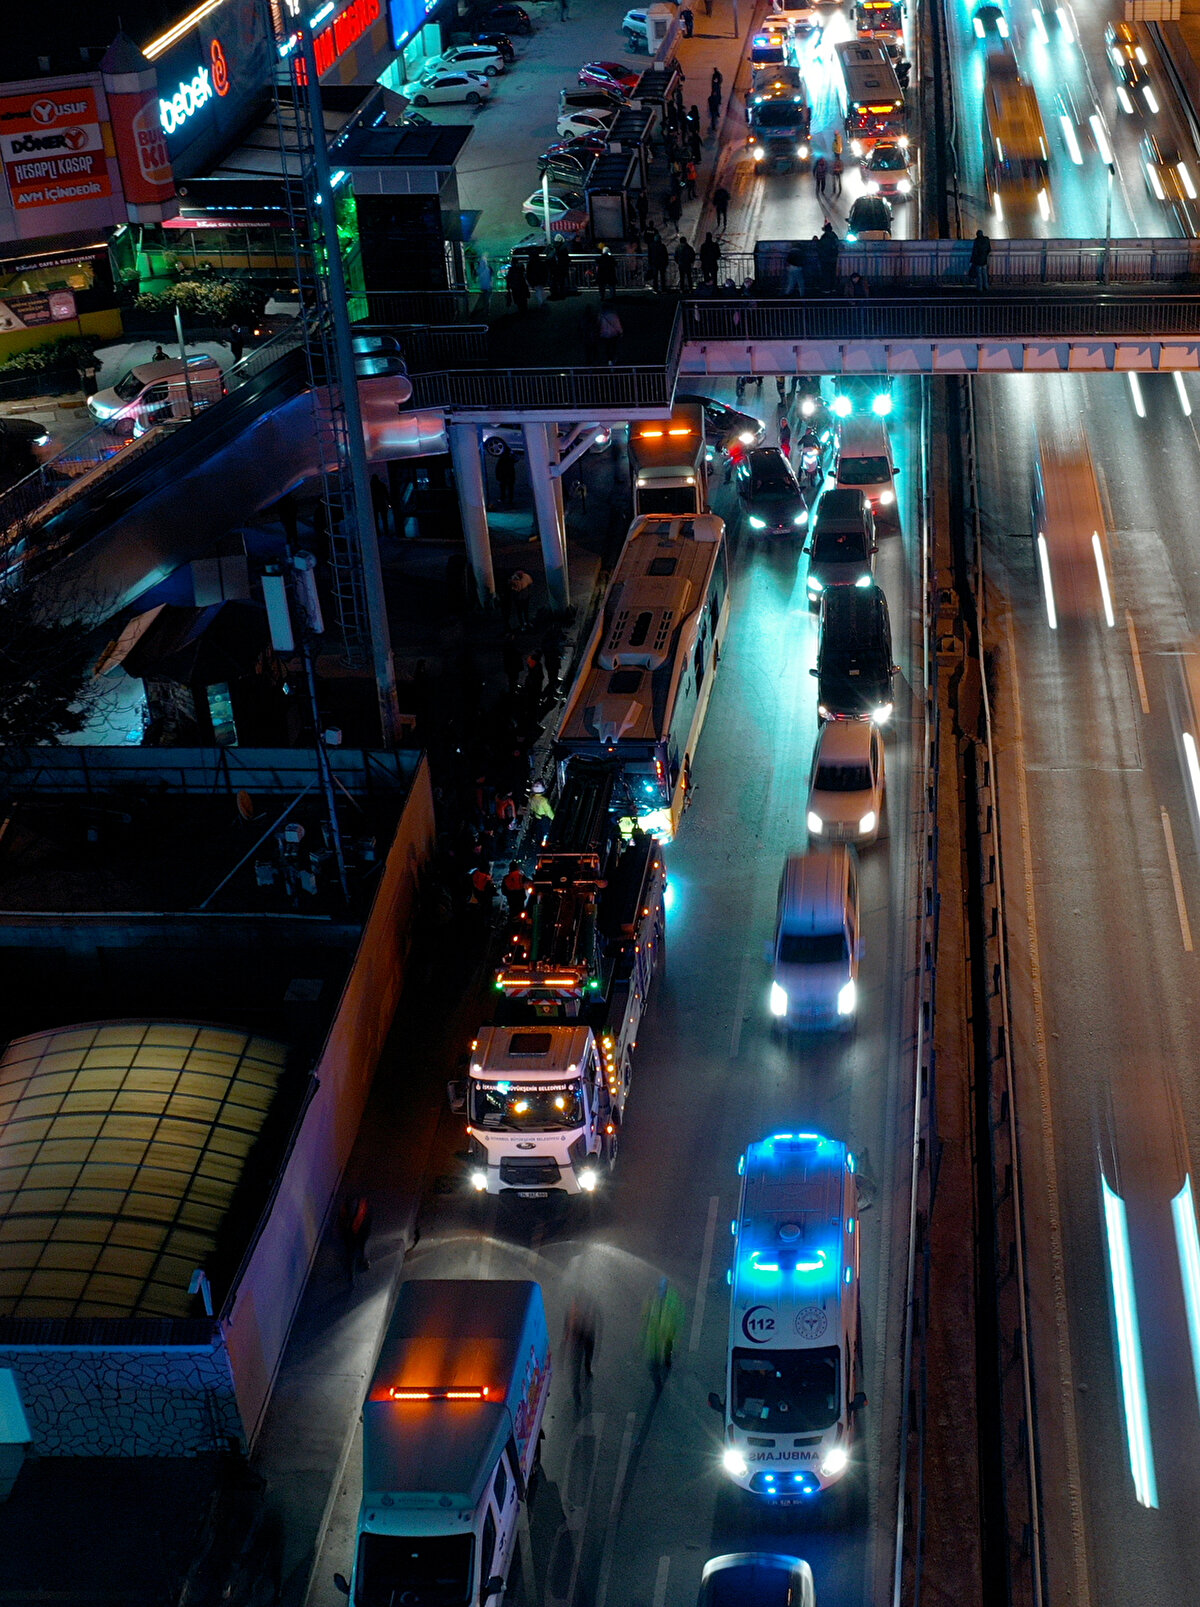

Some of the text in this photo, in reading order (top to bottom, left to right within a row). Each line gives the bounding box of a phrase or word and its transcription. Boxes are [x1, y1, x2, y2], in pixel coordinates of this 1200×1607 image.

[159, 66, 213, 134] bebek
[14, 156, 94, 184] HESAPLI KASAP
[18, 182, 102, 203] AVM İÇİNDEDİR
[748, 1318, 775, 1331] 112
